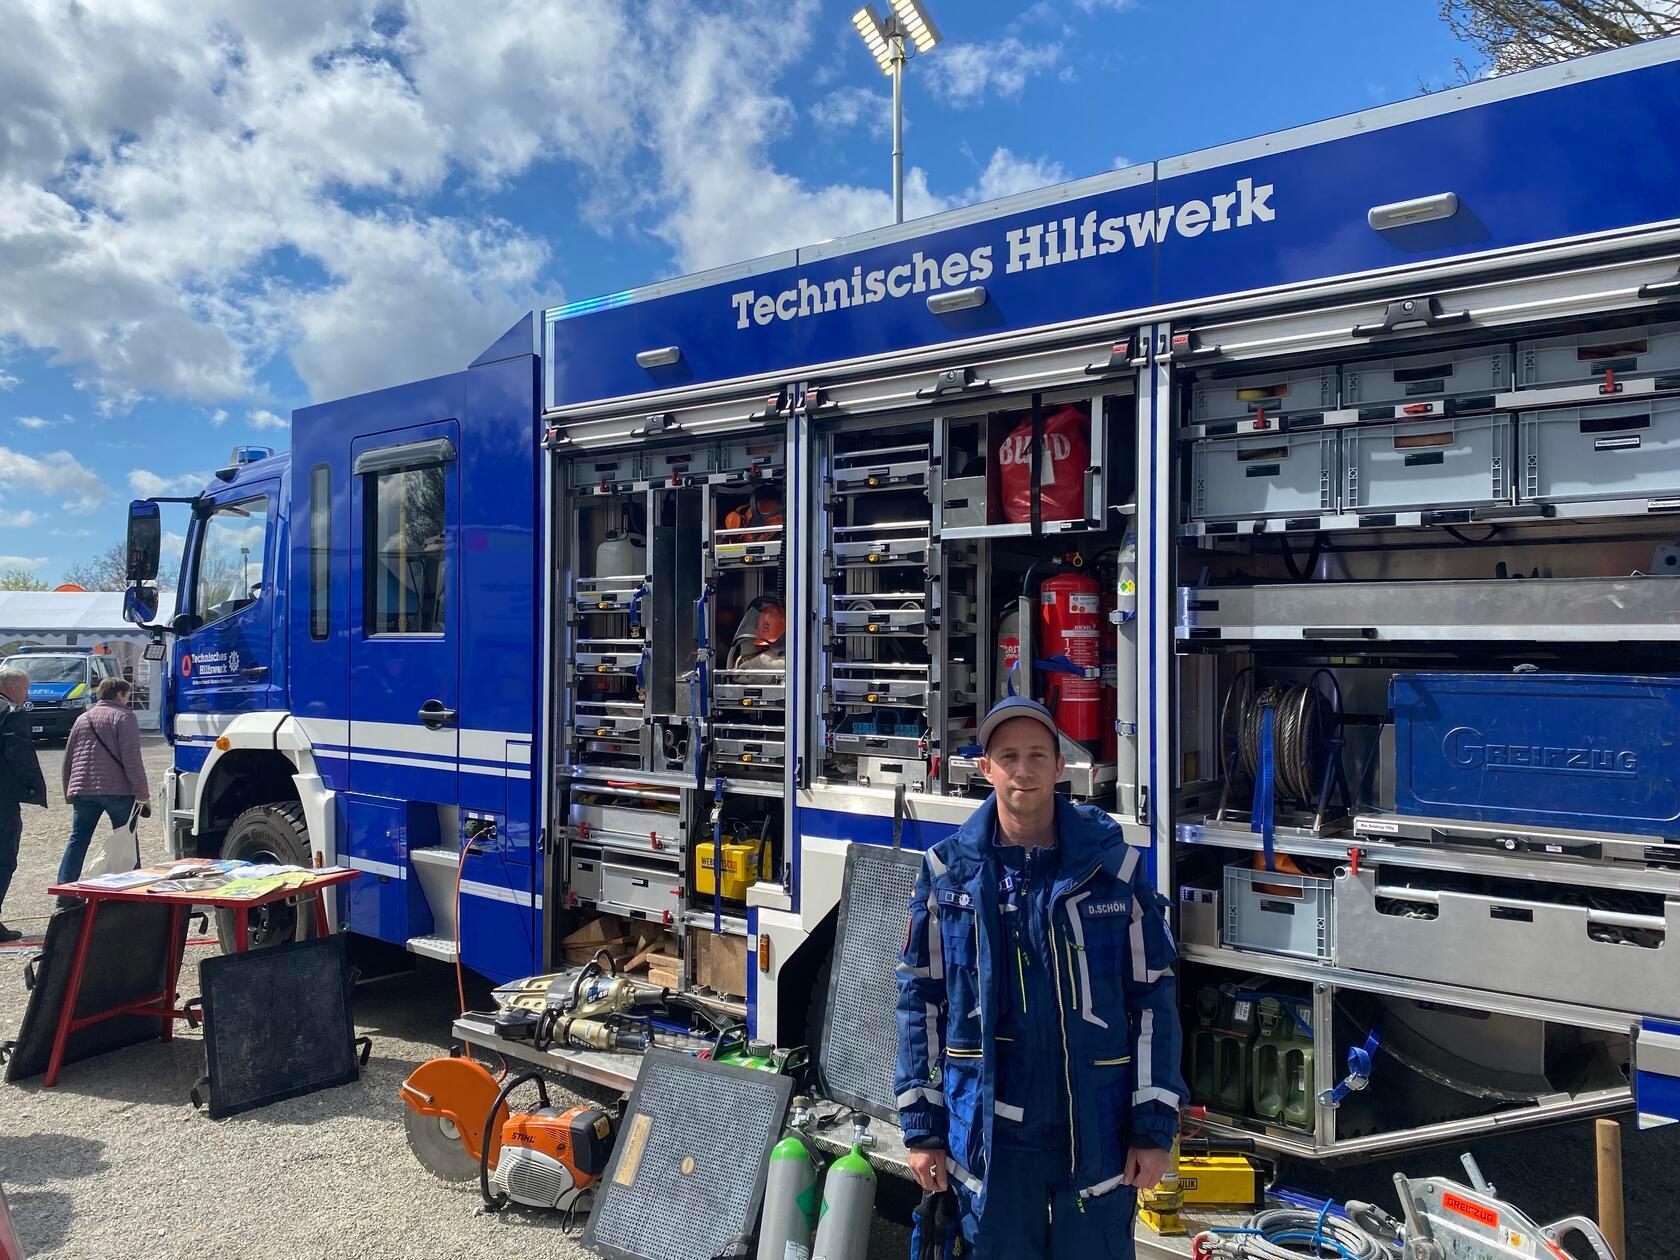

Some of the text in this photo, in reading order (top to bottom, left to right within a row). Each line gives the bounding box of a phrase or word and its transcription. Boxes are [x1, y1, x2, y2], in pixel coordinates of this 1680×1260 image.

[732, 177, 1275, 329] Technisches Hilfswerk
[192, 652, 227, 663] Technisches
[200, 663, 227, 675] Hilfswerk
[1442, 727, 1637, 771] GREIFZUG
[1088, 900, 1126, 915] D.SCHÖN
[511, 1132, 535, 1143] STIHL
[1447, 1198, 1493, 1223] GREIFZUG
